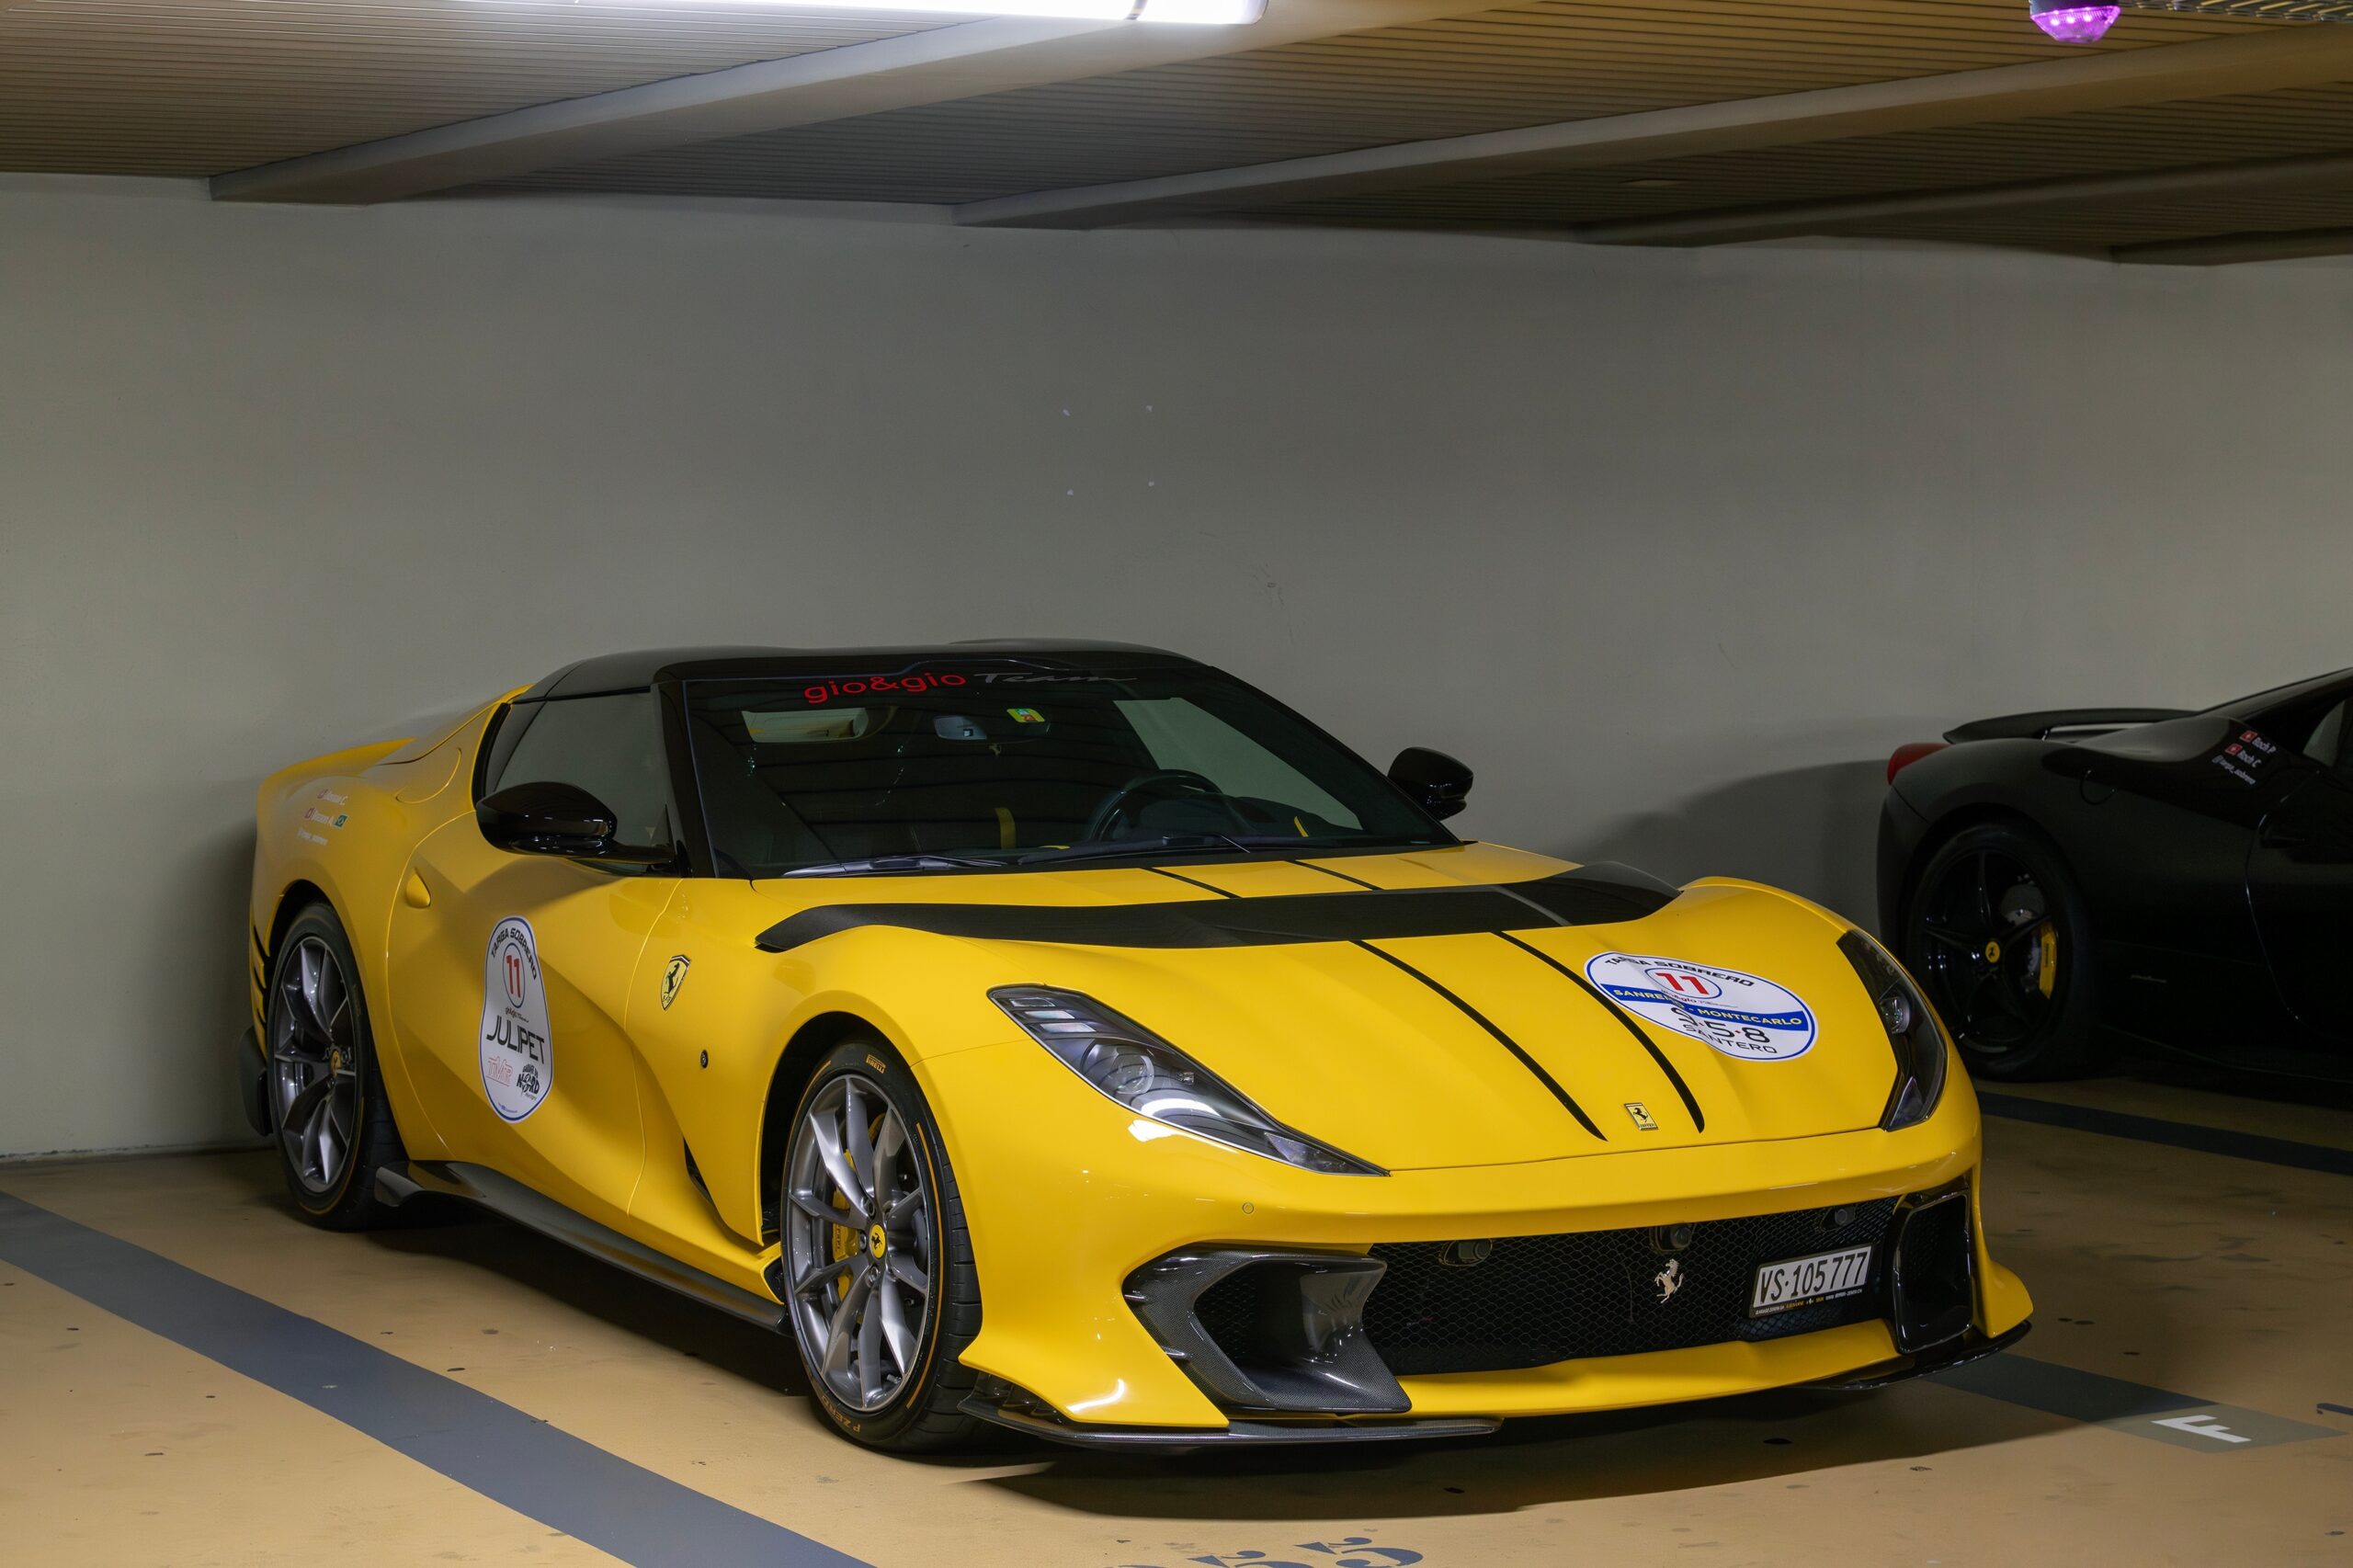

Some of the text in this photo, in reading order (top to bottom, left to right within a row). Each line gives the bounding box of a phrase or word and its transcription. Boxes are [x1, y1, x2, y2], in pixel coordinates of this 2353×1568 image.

[803, 672, 966, 704] gio&gio
[506, 954, 521, 998] 11
[1654, 961, 1755, 987] SOBRERO
[1654, 972, 1710, 995] 11
[1699, 1008, 1802, 1025] MONTECARLO
[486, 1015, 545, 1064] JULIPET
[2150, 1414, 2252, 1443] F
